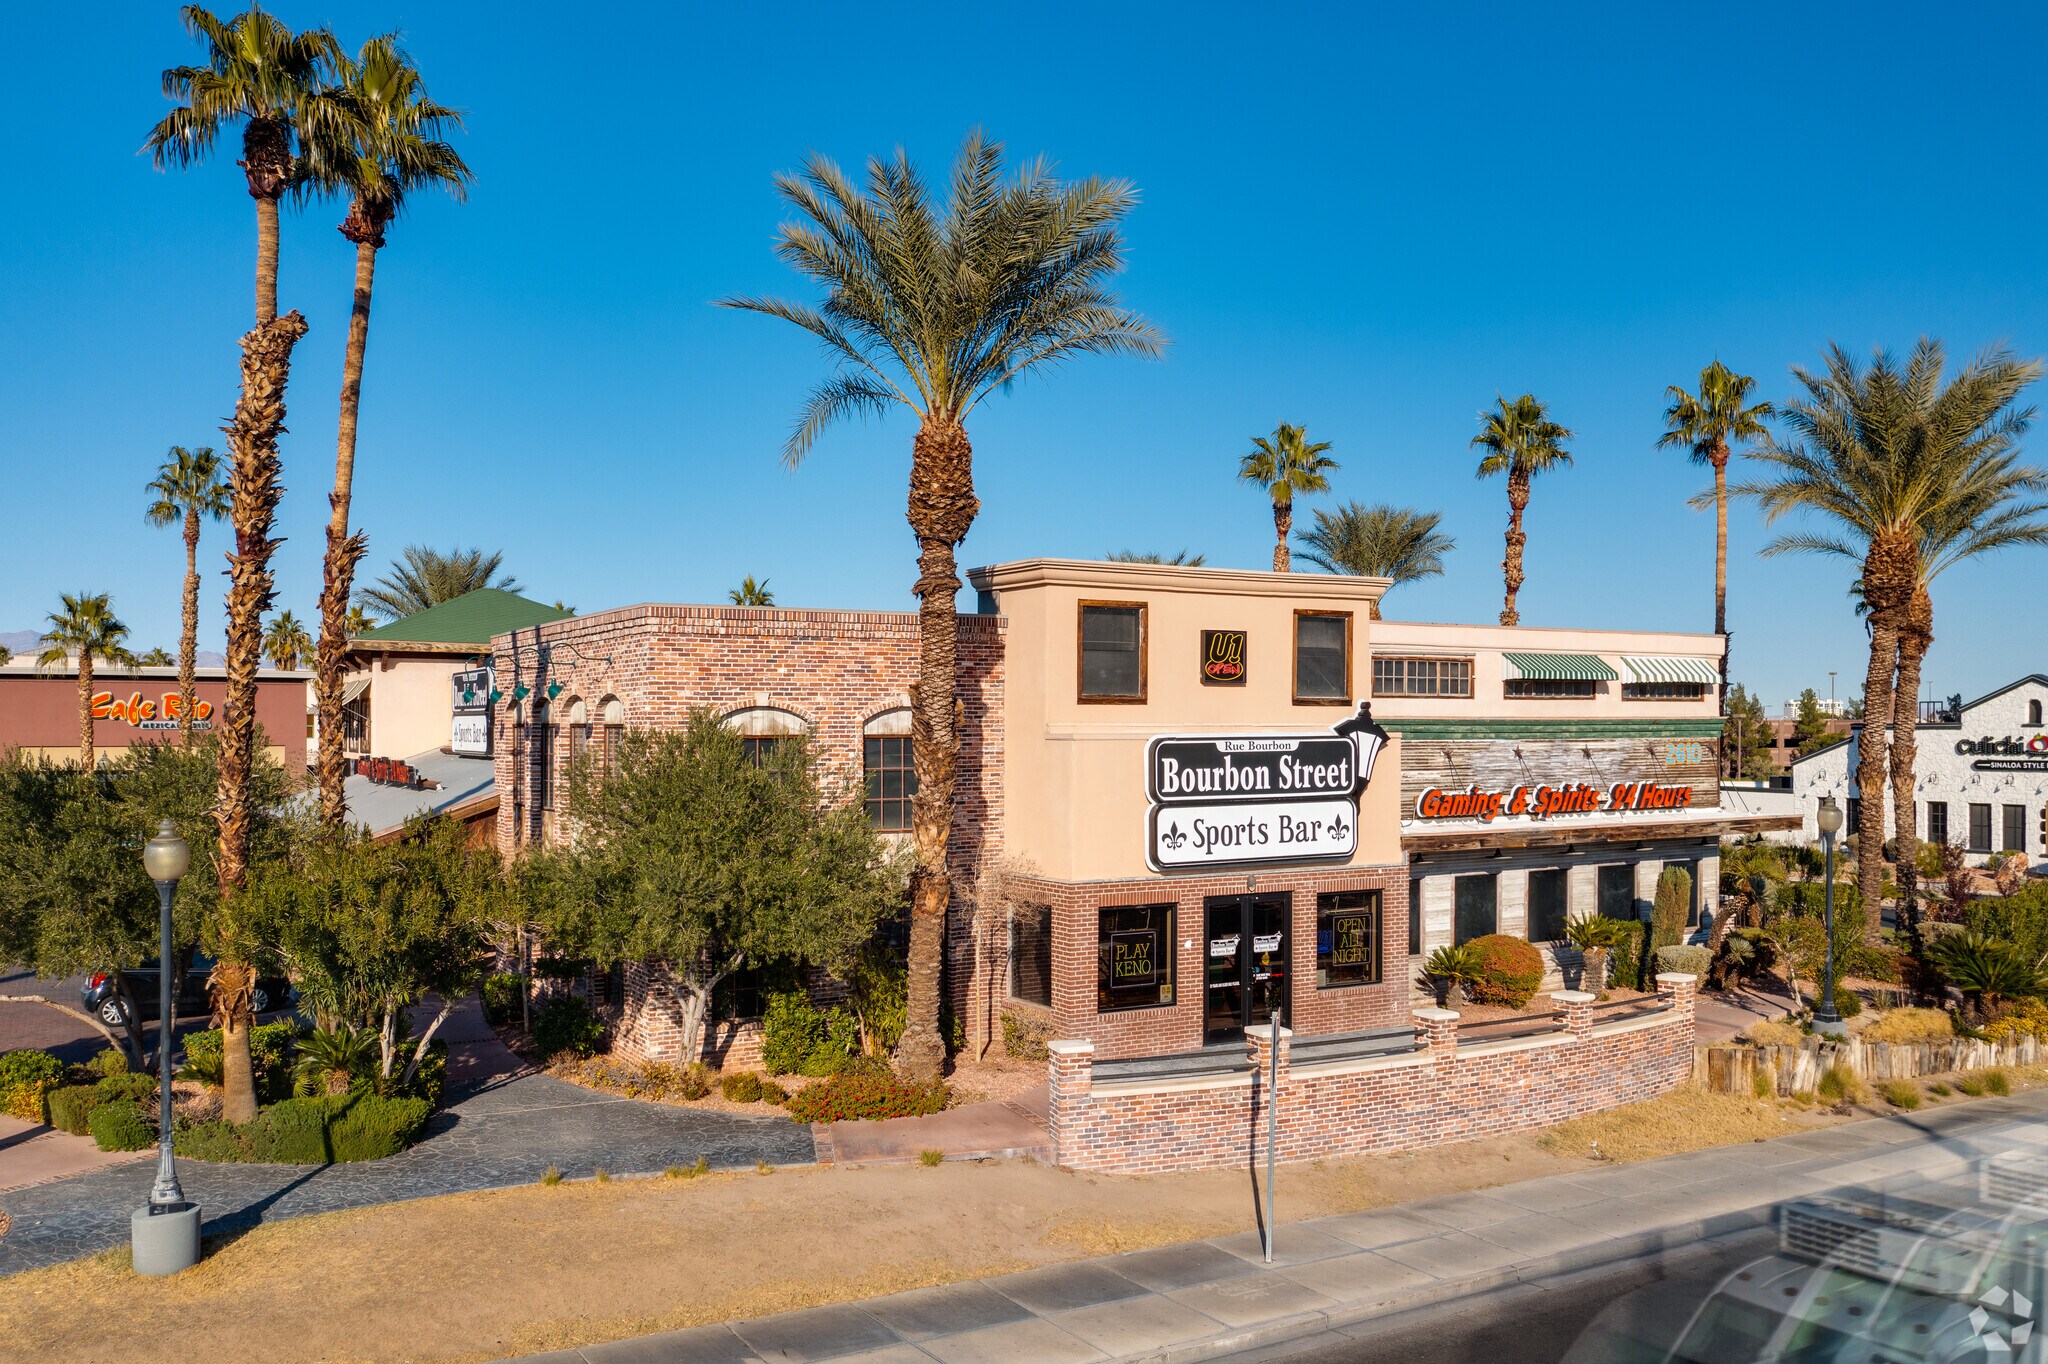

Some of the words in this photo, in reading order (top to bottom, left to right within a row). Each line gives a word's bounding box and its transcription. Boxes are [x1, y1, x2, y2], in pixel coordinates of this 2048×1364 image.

[1207, 662, 1241, 675] OPEN
[142, 721, 181, 729] MEXICA
[1225, 741, 1245, 751] Rue
[1248, 741, 1291, 750] Bourbon
[1665, 742, 1702, 765] 2610
[1161, 755, 1271, 793] Bourbon
[1279, 754, 1349, 789] Street
[1419, 786, 1503, 821] Gaming
[1508, 785, 1528, 815] &
[1532, 782, 1600, 818] Spirits
[1609, 783, 1638, 810] 24
[1639, 782, 1693, 809] Hours
[1192, 816, 1269, 855] Sports
[1278, 815, 1322, 844] Bar
[1337, 917, 1366, 933] OPEN
[1340, 932, 1364, 949] ALL
[1116, 943, 1150, 960] PLAY
[1333, 947, 1370, 964] NIGHT
[1115, 960, 1151, 977] KENO
